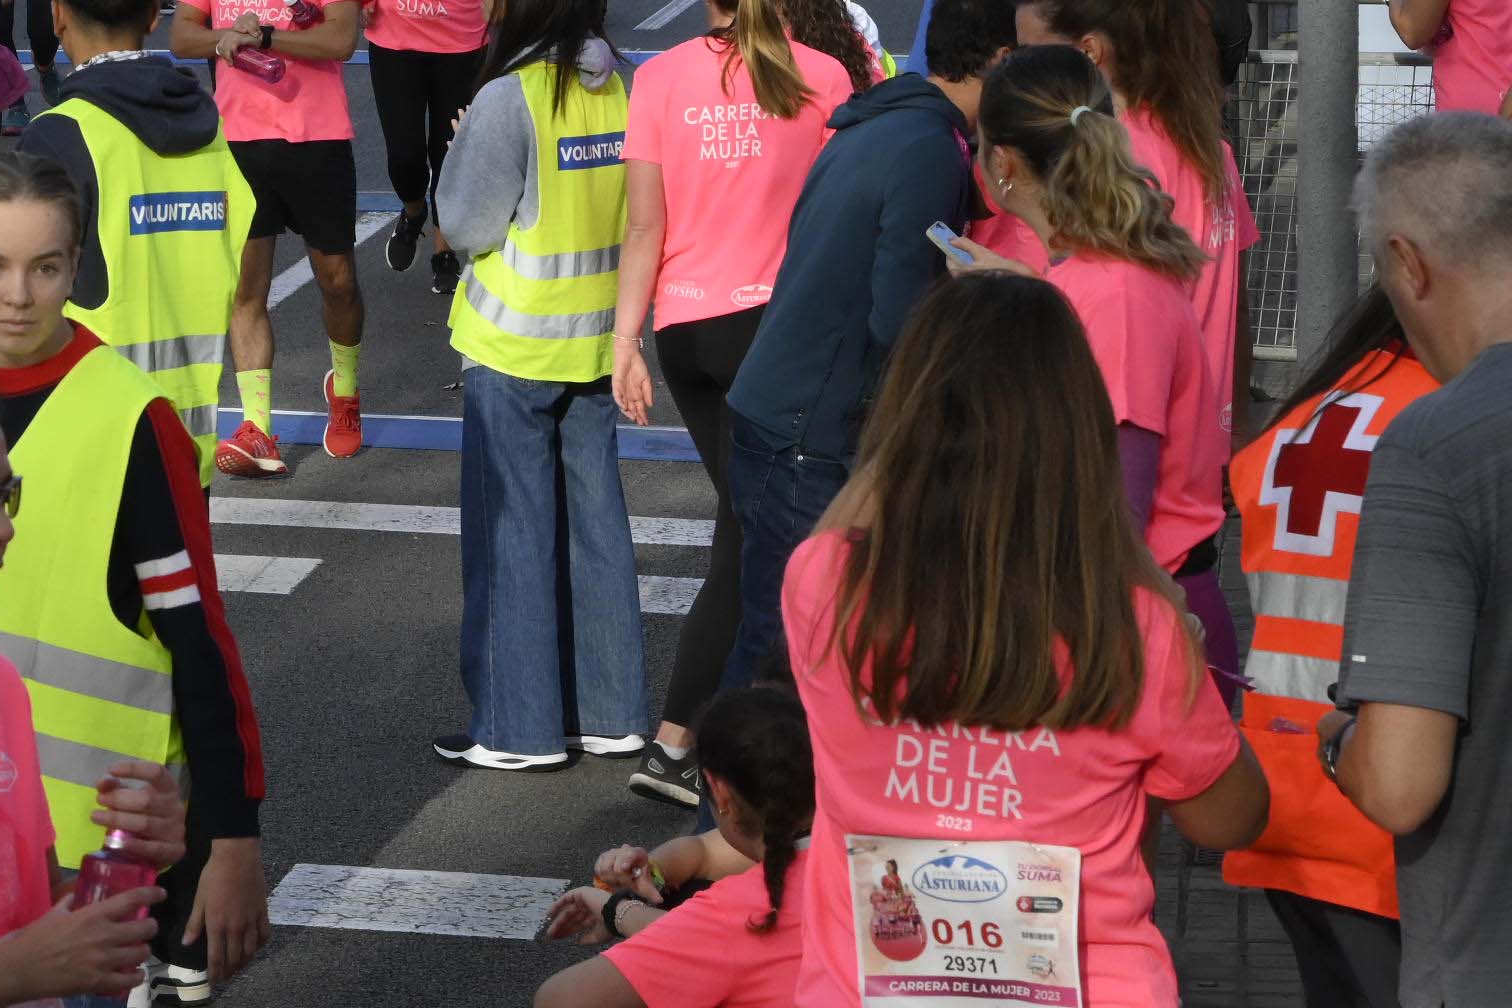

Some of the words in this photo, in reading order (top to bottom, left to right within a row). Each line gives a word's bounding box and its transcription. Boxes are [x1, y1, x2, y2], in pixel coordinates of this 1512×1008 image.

[219, 8, 239, 22] LAS
[703, 124, 728, 142] DE
[736, 122, 759, 138] LA
[560, 141, 622, 161] VOLUNTAR
[700, 140, 762, 160] MUJER
[132, 202, 224, 224] VOLUNTARIS
[664, 283, 704, 300] OYSHO
[896, 735, 948, 774] DE
[968, 751, 1018, 786] LA
[885, 768, 1023, 820] MUJER
[936, 814, 973, 833] 2023
[920, 872, 1000, 892] ASTURIANA
[1016, 871, 1062, 882] SUMA
[931, 918, 1003, 948] 016
[944, 956, 997, 974] 29371
[889, 981, 949, 991] CARRERA
[953, 982, 970, 991] DE
[973, 982, 987, 992] LA
[991, 984, 1031, 997] MUJER
[1034, 989, 1061, 1001] 2023
